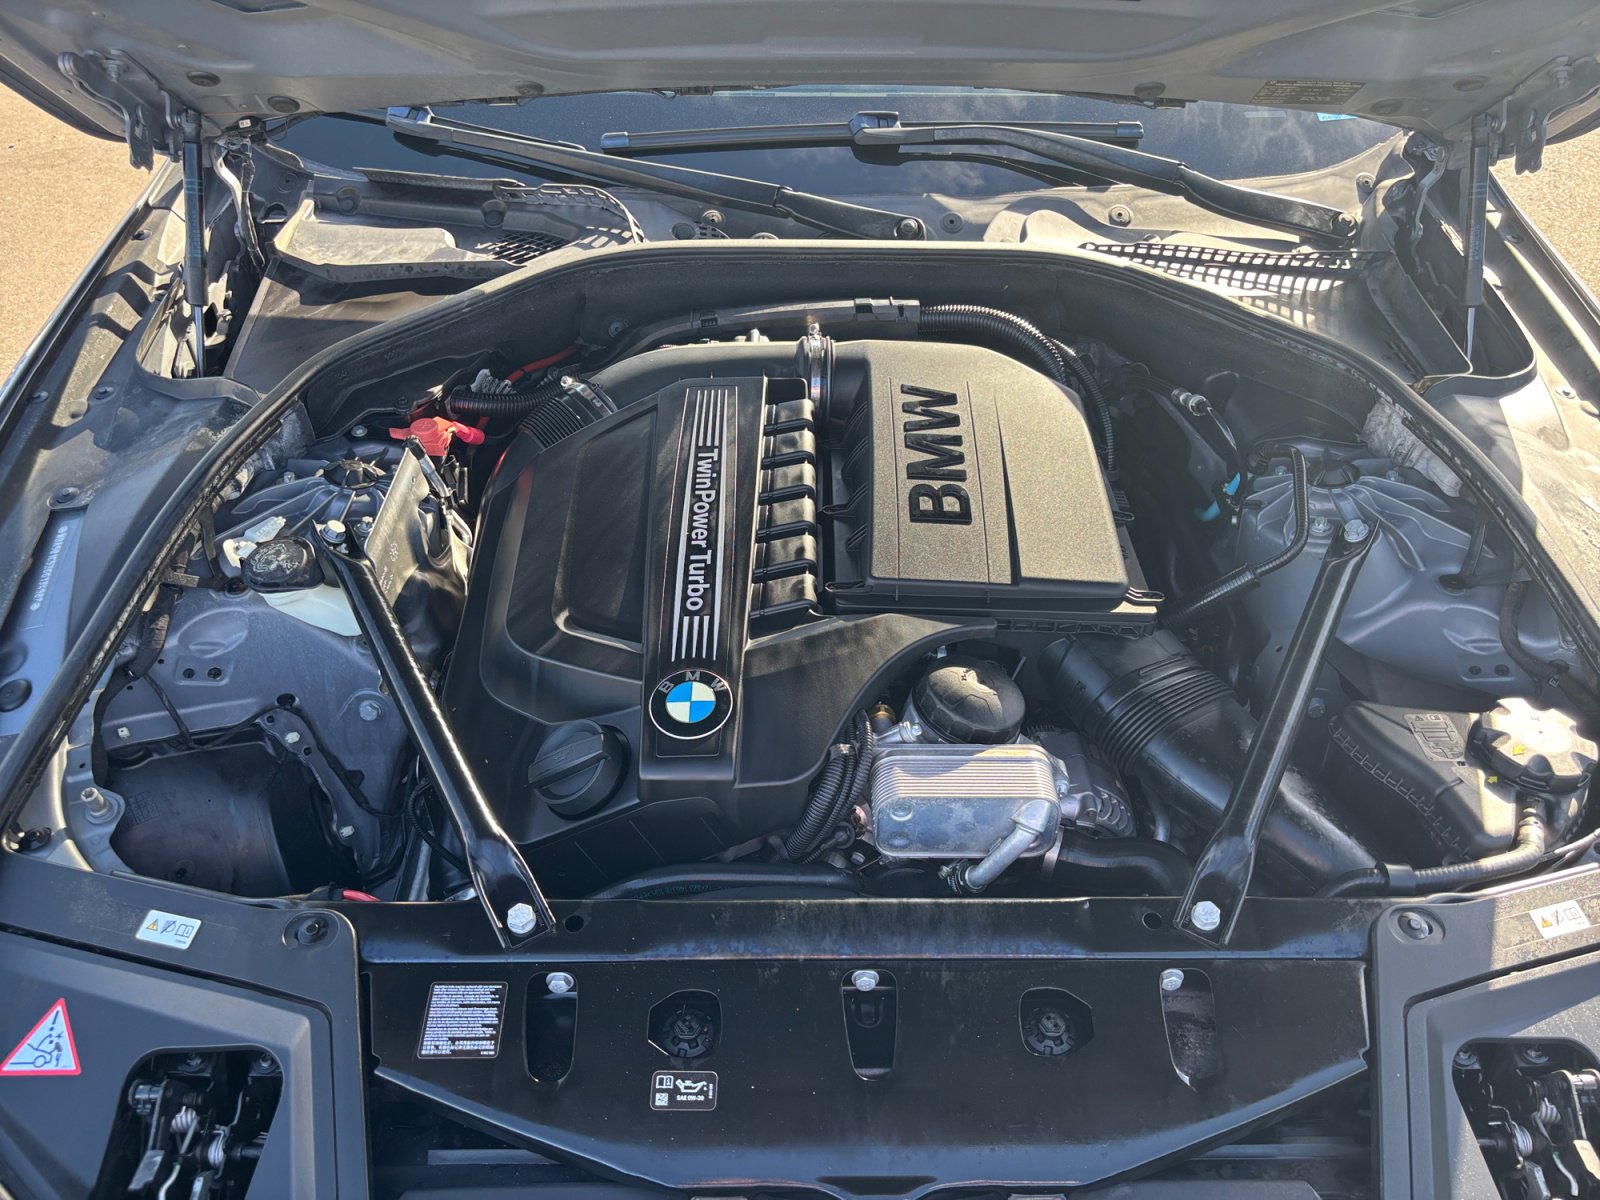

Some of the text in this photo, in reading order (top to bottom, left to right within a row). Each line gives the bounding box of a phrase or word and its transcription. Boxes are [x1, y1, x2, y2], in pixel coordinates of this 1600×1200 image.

[901, 384, 972, 525] BMW
[686, 448, 719, 611] TwinPower Turbo
[658, 671, 727, 694] BMW
